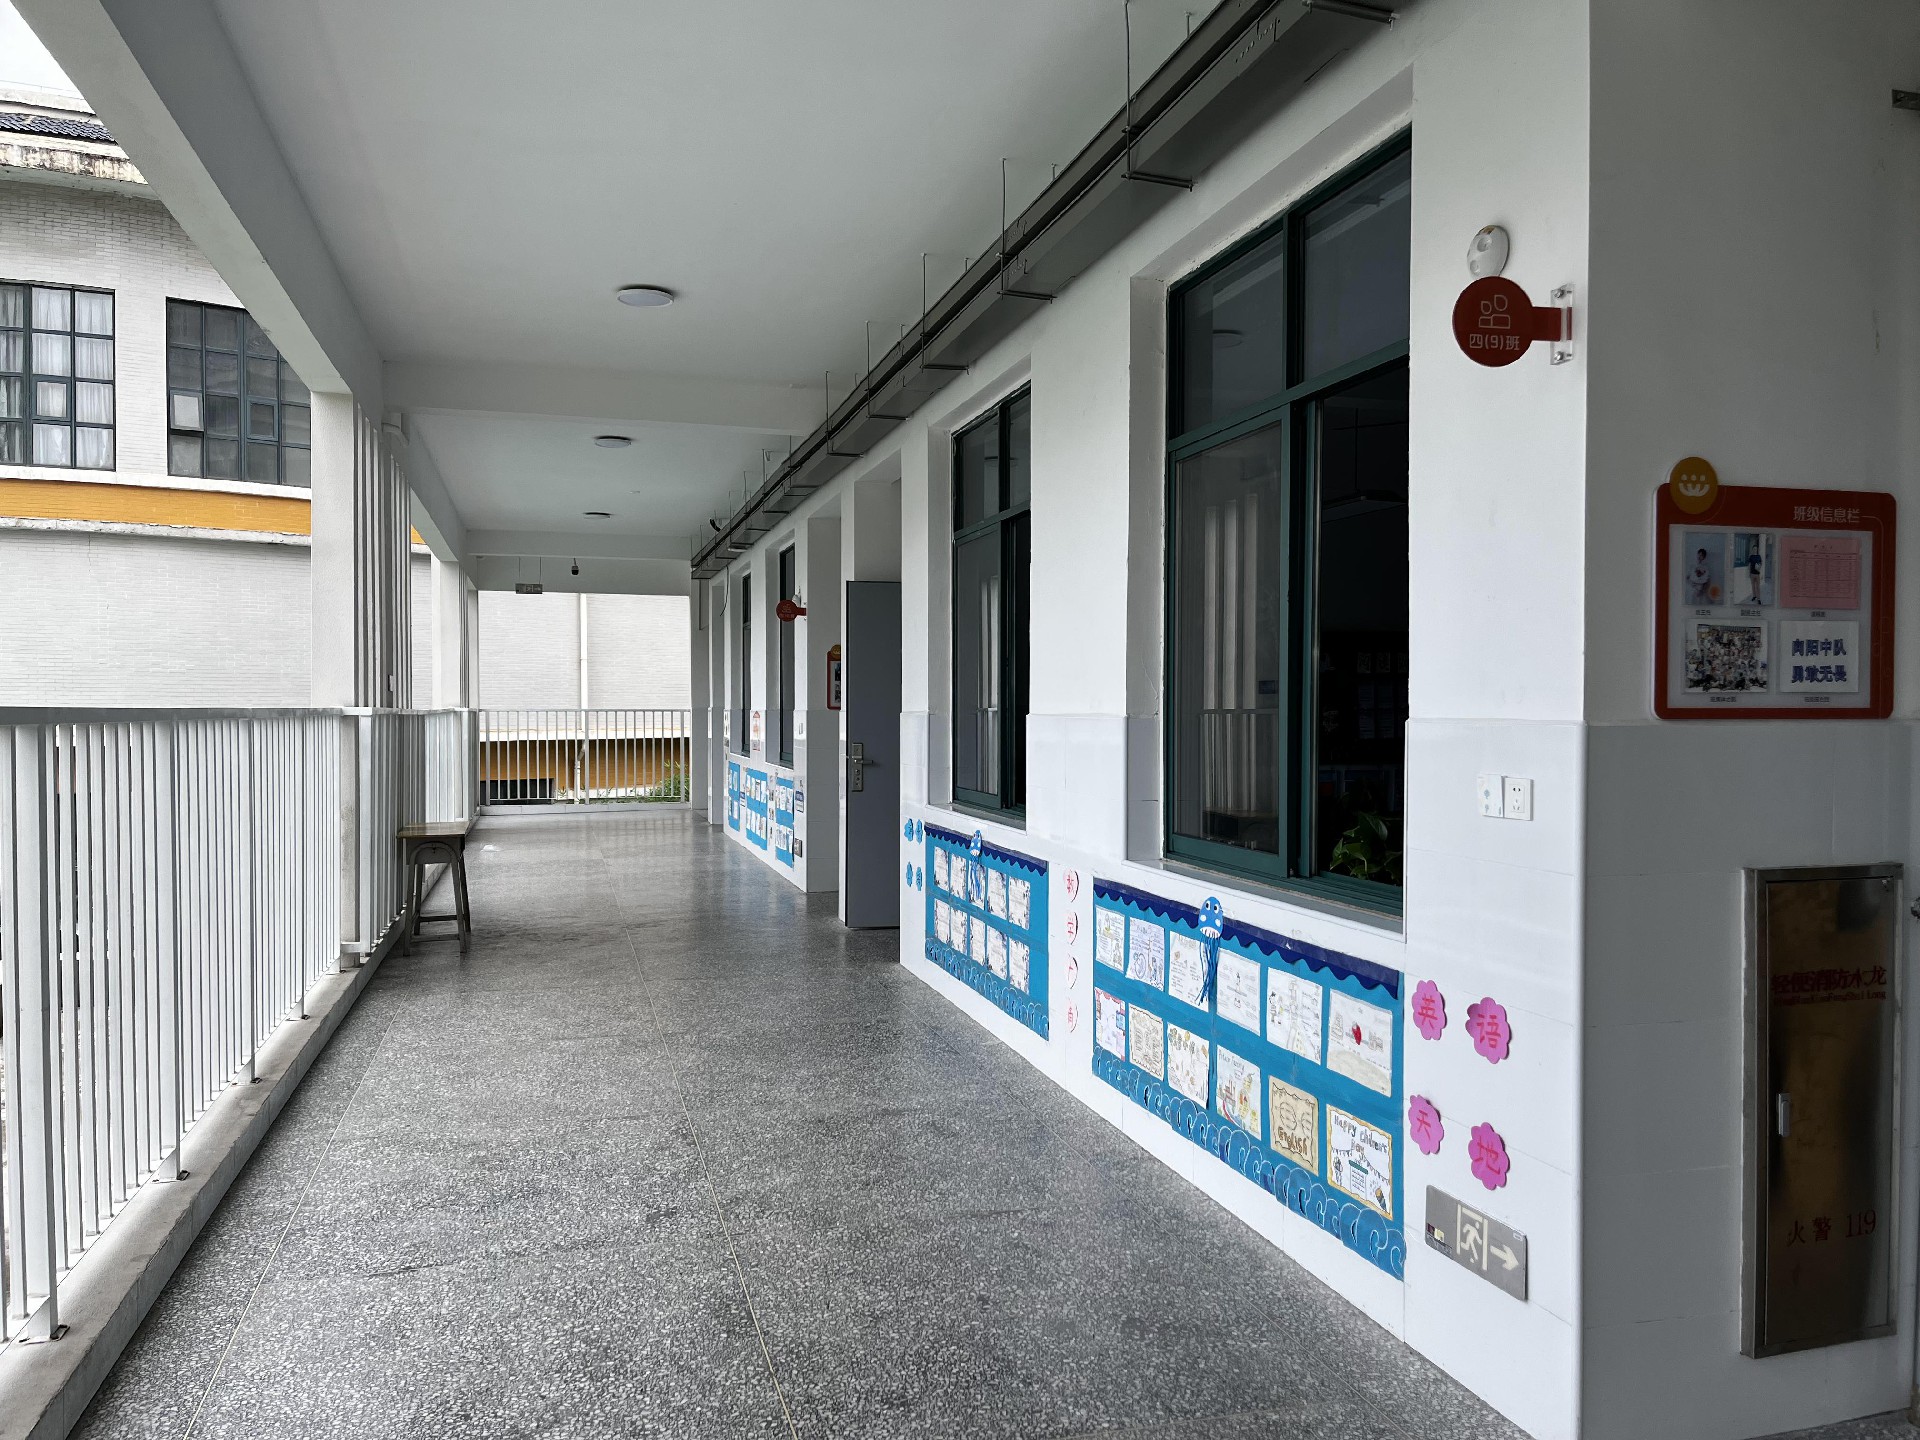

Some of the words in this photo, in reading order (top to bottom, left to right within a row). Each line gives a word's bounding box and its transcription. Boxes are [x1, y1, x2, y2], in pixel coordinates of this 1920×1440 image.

[1470, 333, 1520, 351] 四(9)班
[1793, 506, 1860, 524] 班级信息栏
[1791, 664, 1848, 683] 勇敢无畏
[1845, 1209, 1877, 1239] 119
